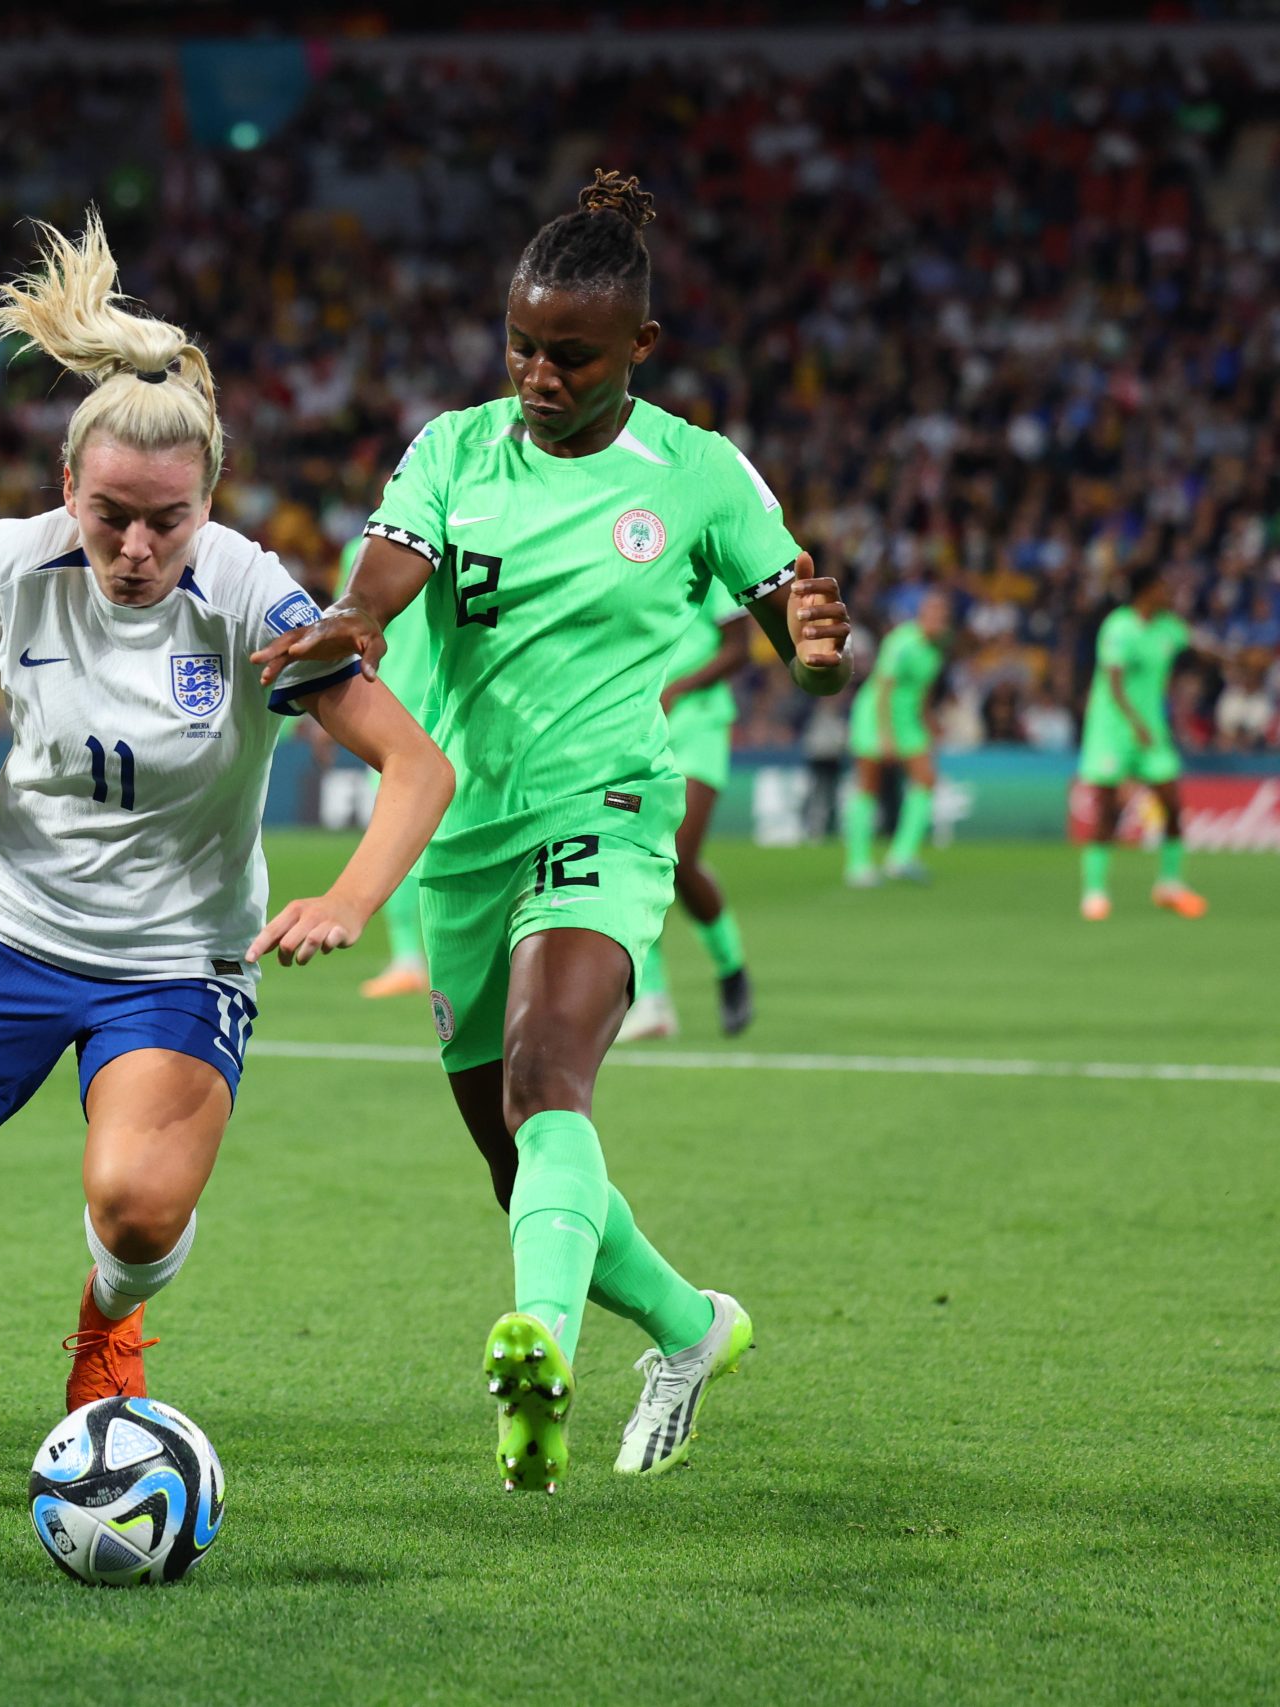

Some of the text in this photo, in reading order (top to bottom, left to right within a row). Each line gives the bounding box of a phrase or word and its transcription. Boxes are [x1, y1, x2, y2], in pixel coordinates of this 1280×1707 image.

[620, 511, 651, 524] FOOTBALL
[444, 543, 503, 629] 12
[279, 599, 308, 621] FOOTBALL
[285, 606, 314, 628] UNITES
[186, 731, 206, 739] AUGUST
[190, 722, 210, 730] NIGERIA
[84, 734, 135, 812] 11
[532, 834, 600, 897] 12
[206, 982, 251, 1058] 11
